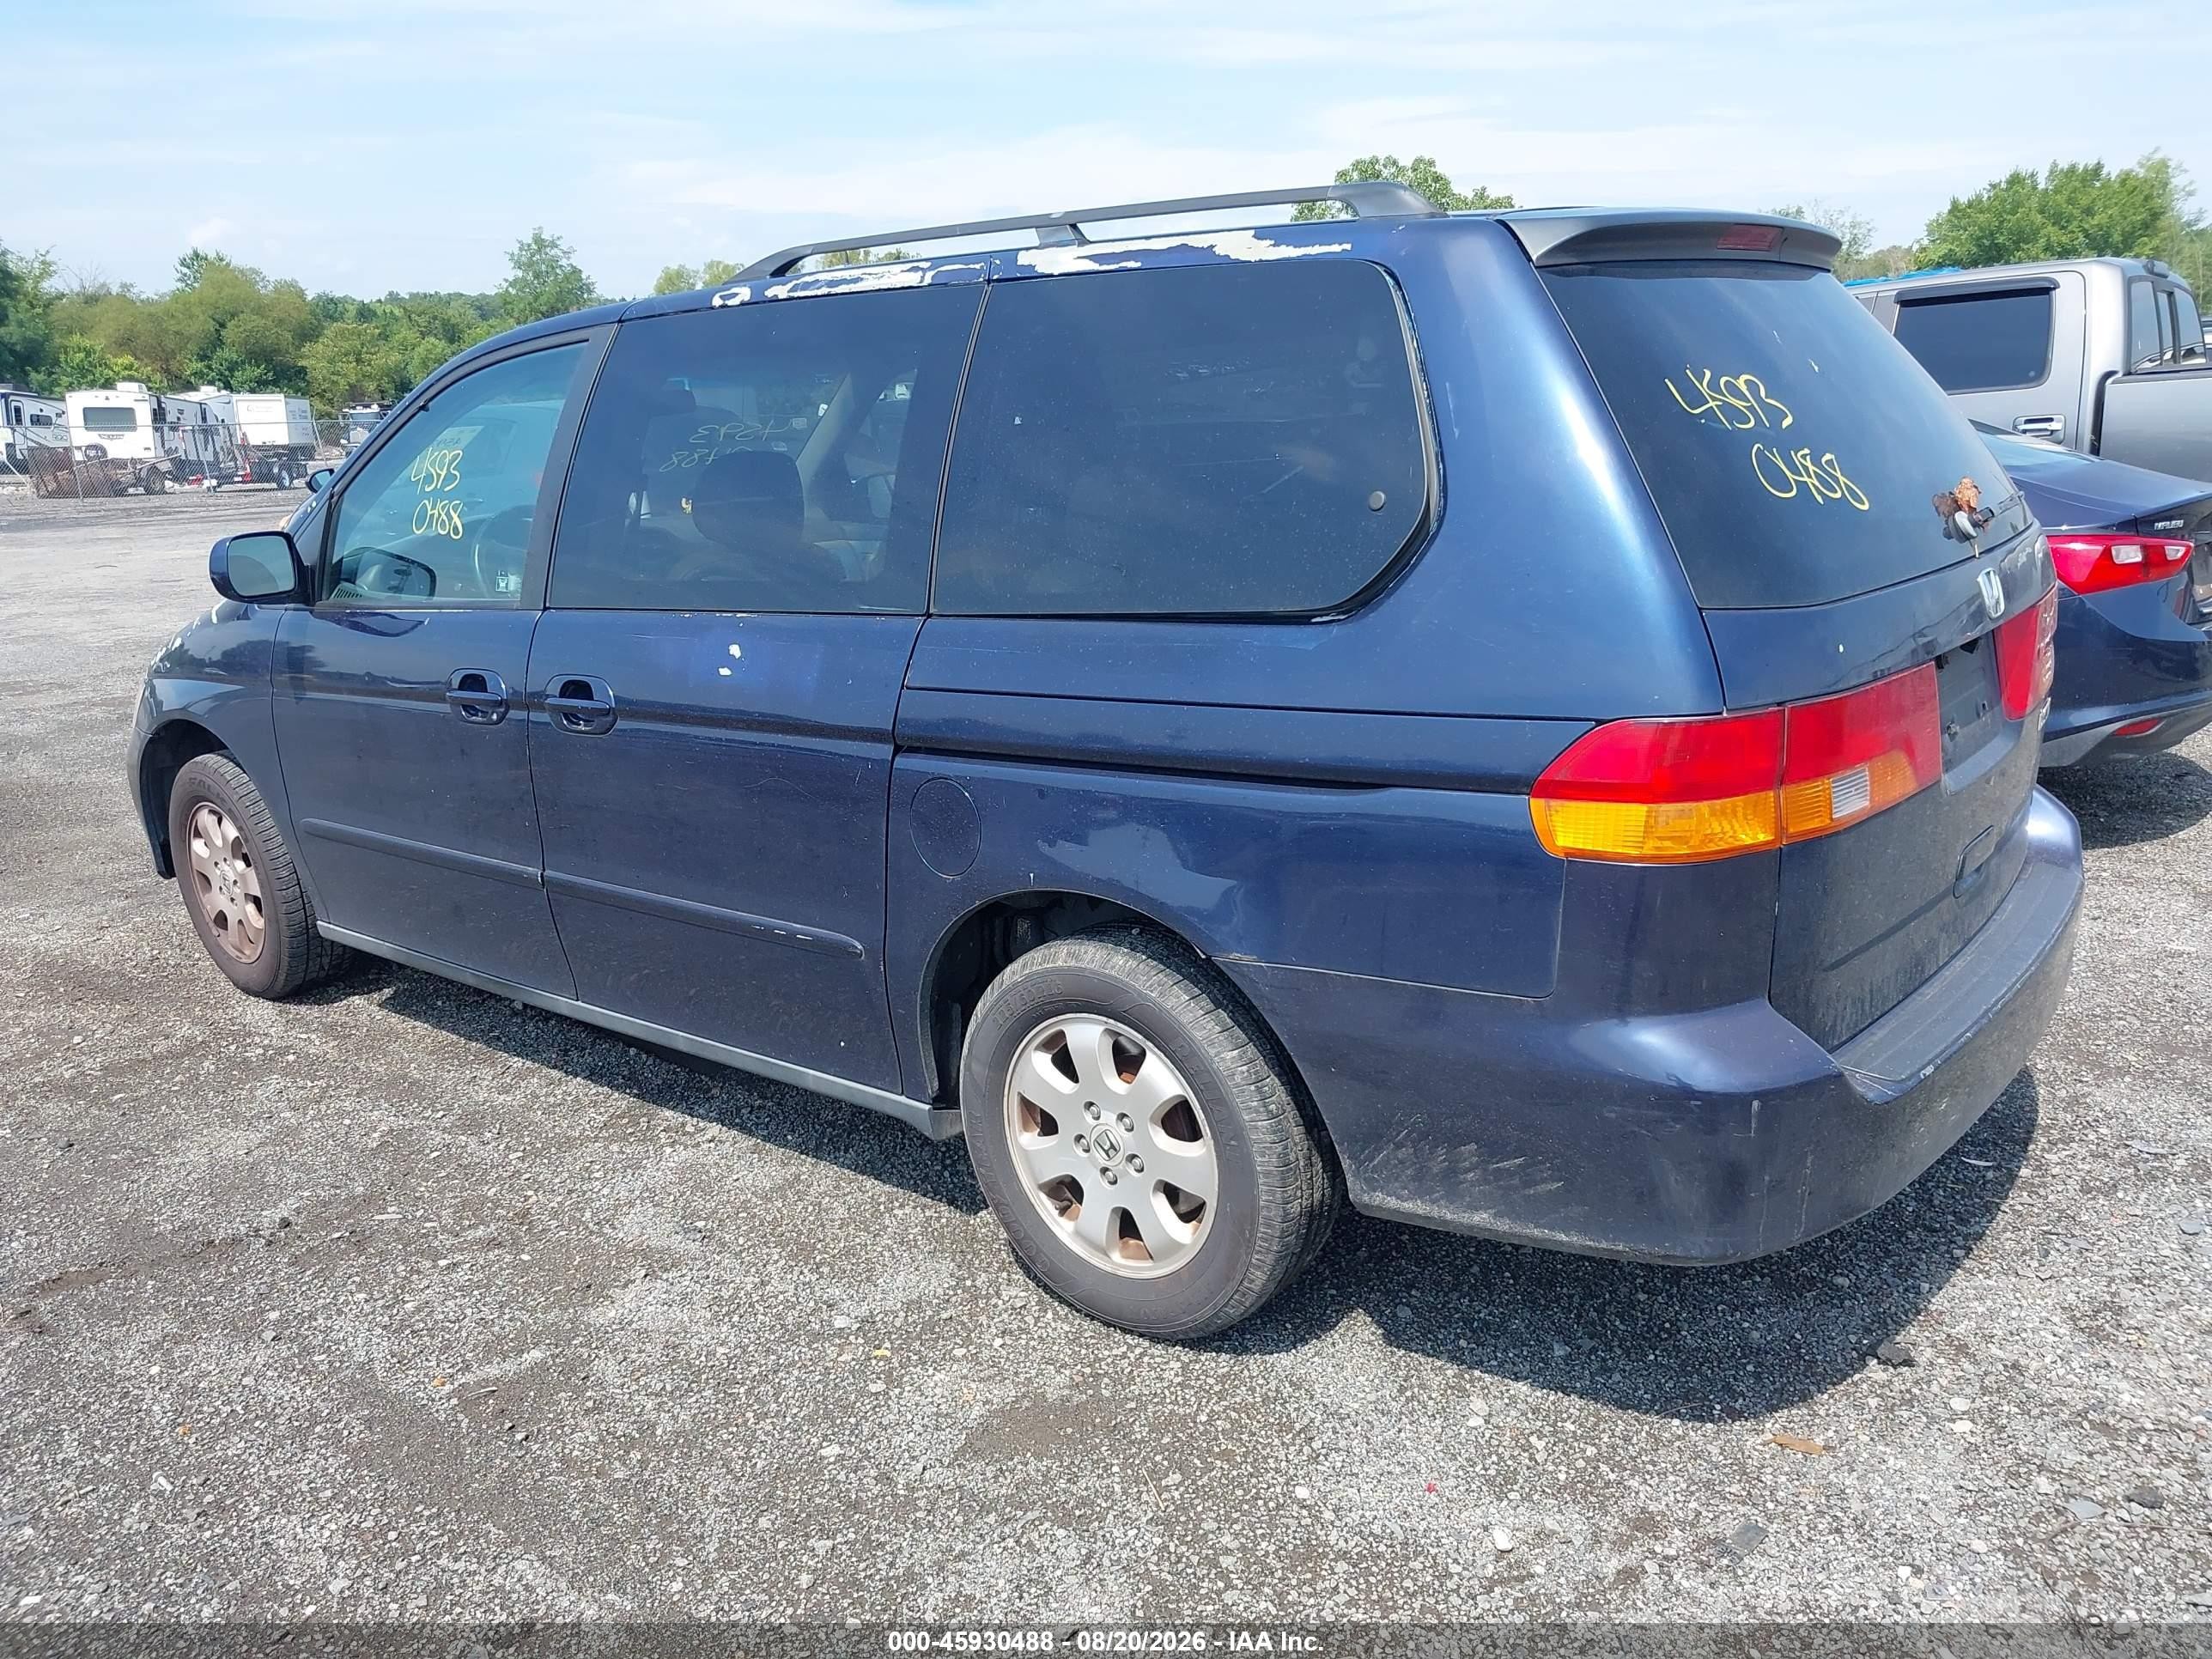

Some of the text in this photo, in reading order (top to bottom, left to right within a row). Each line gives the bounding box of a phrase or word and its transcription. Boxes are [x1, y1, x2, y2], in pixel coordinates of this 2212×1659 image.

[1664, 368, 1794, 430] 4593
[410, 447, 464, 495] 4593
[1751, 442, 1870, 511] 0488
[412, 496, 464, 540] 0488
